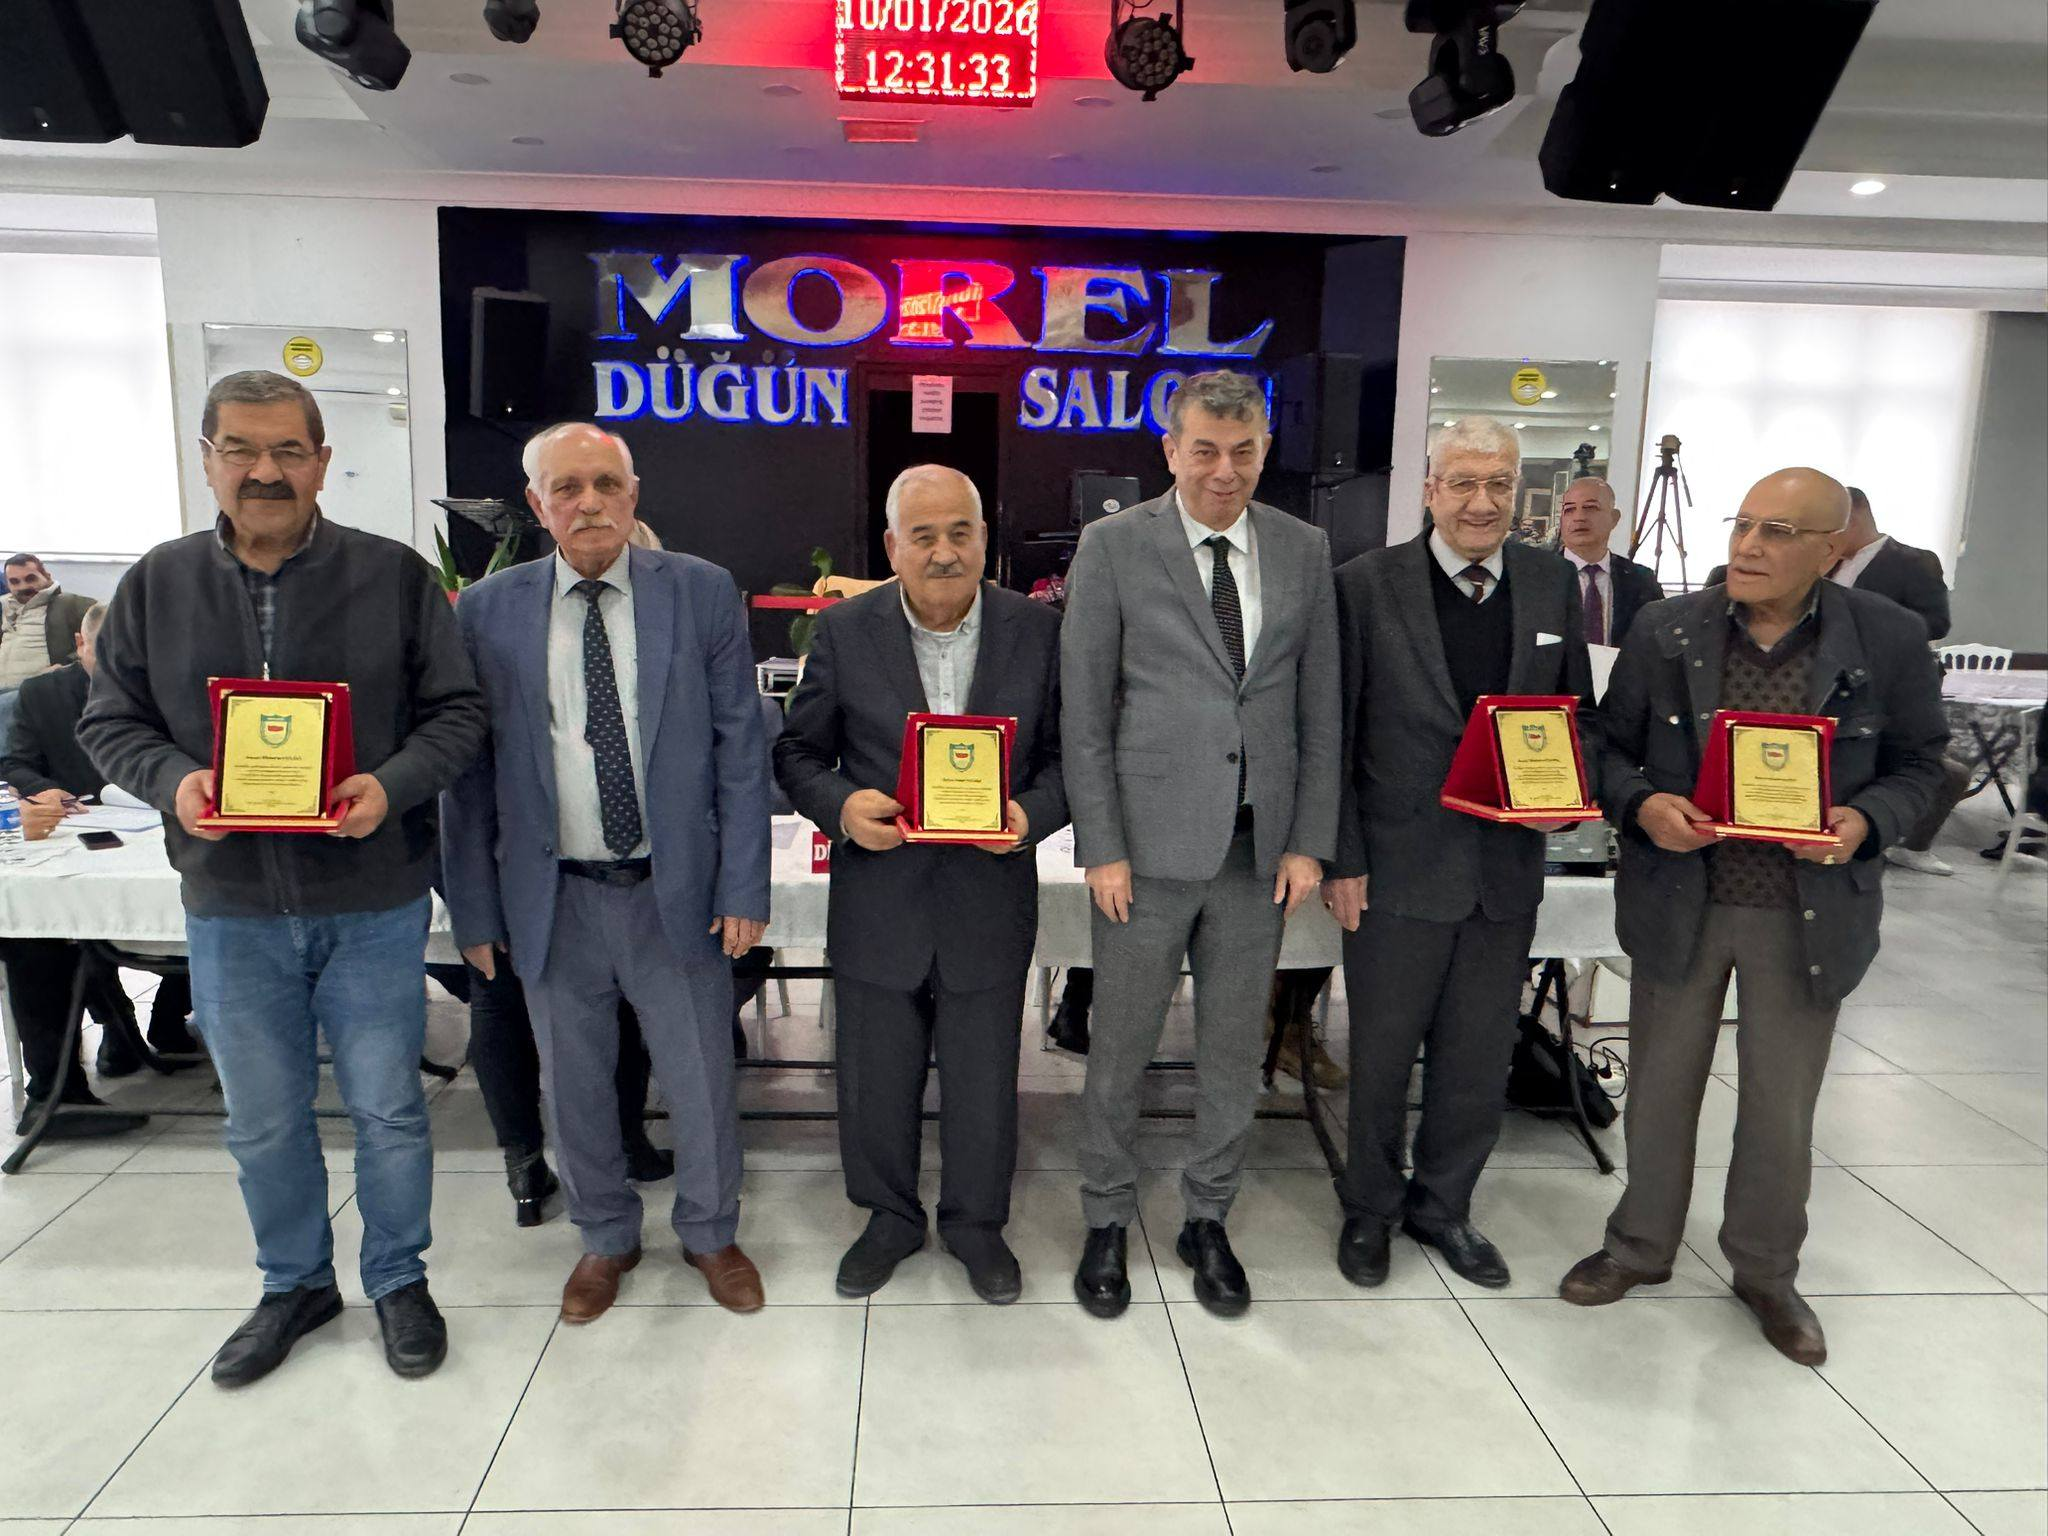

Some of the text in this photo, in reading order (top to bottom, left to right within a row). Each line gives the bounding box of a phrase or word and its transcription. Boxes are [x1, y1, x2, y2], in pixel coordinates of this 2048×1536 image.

[840, 0, 1038, 36] 10/01/2026
[865, 50, 1010, 91] 12:31:33
[590, 251, 1275, 358] MOREL
[591, 345, 851, 427] DÜĞÜN
